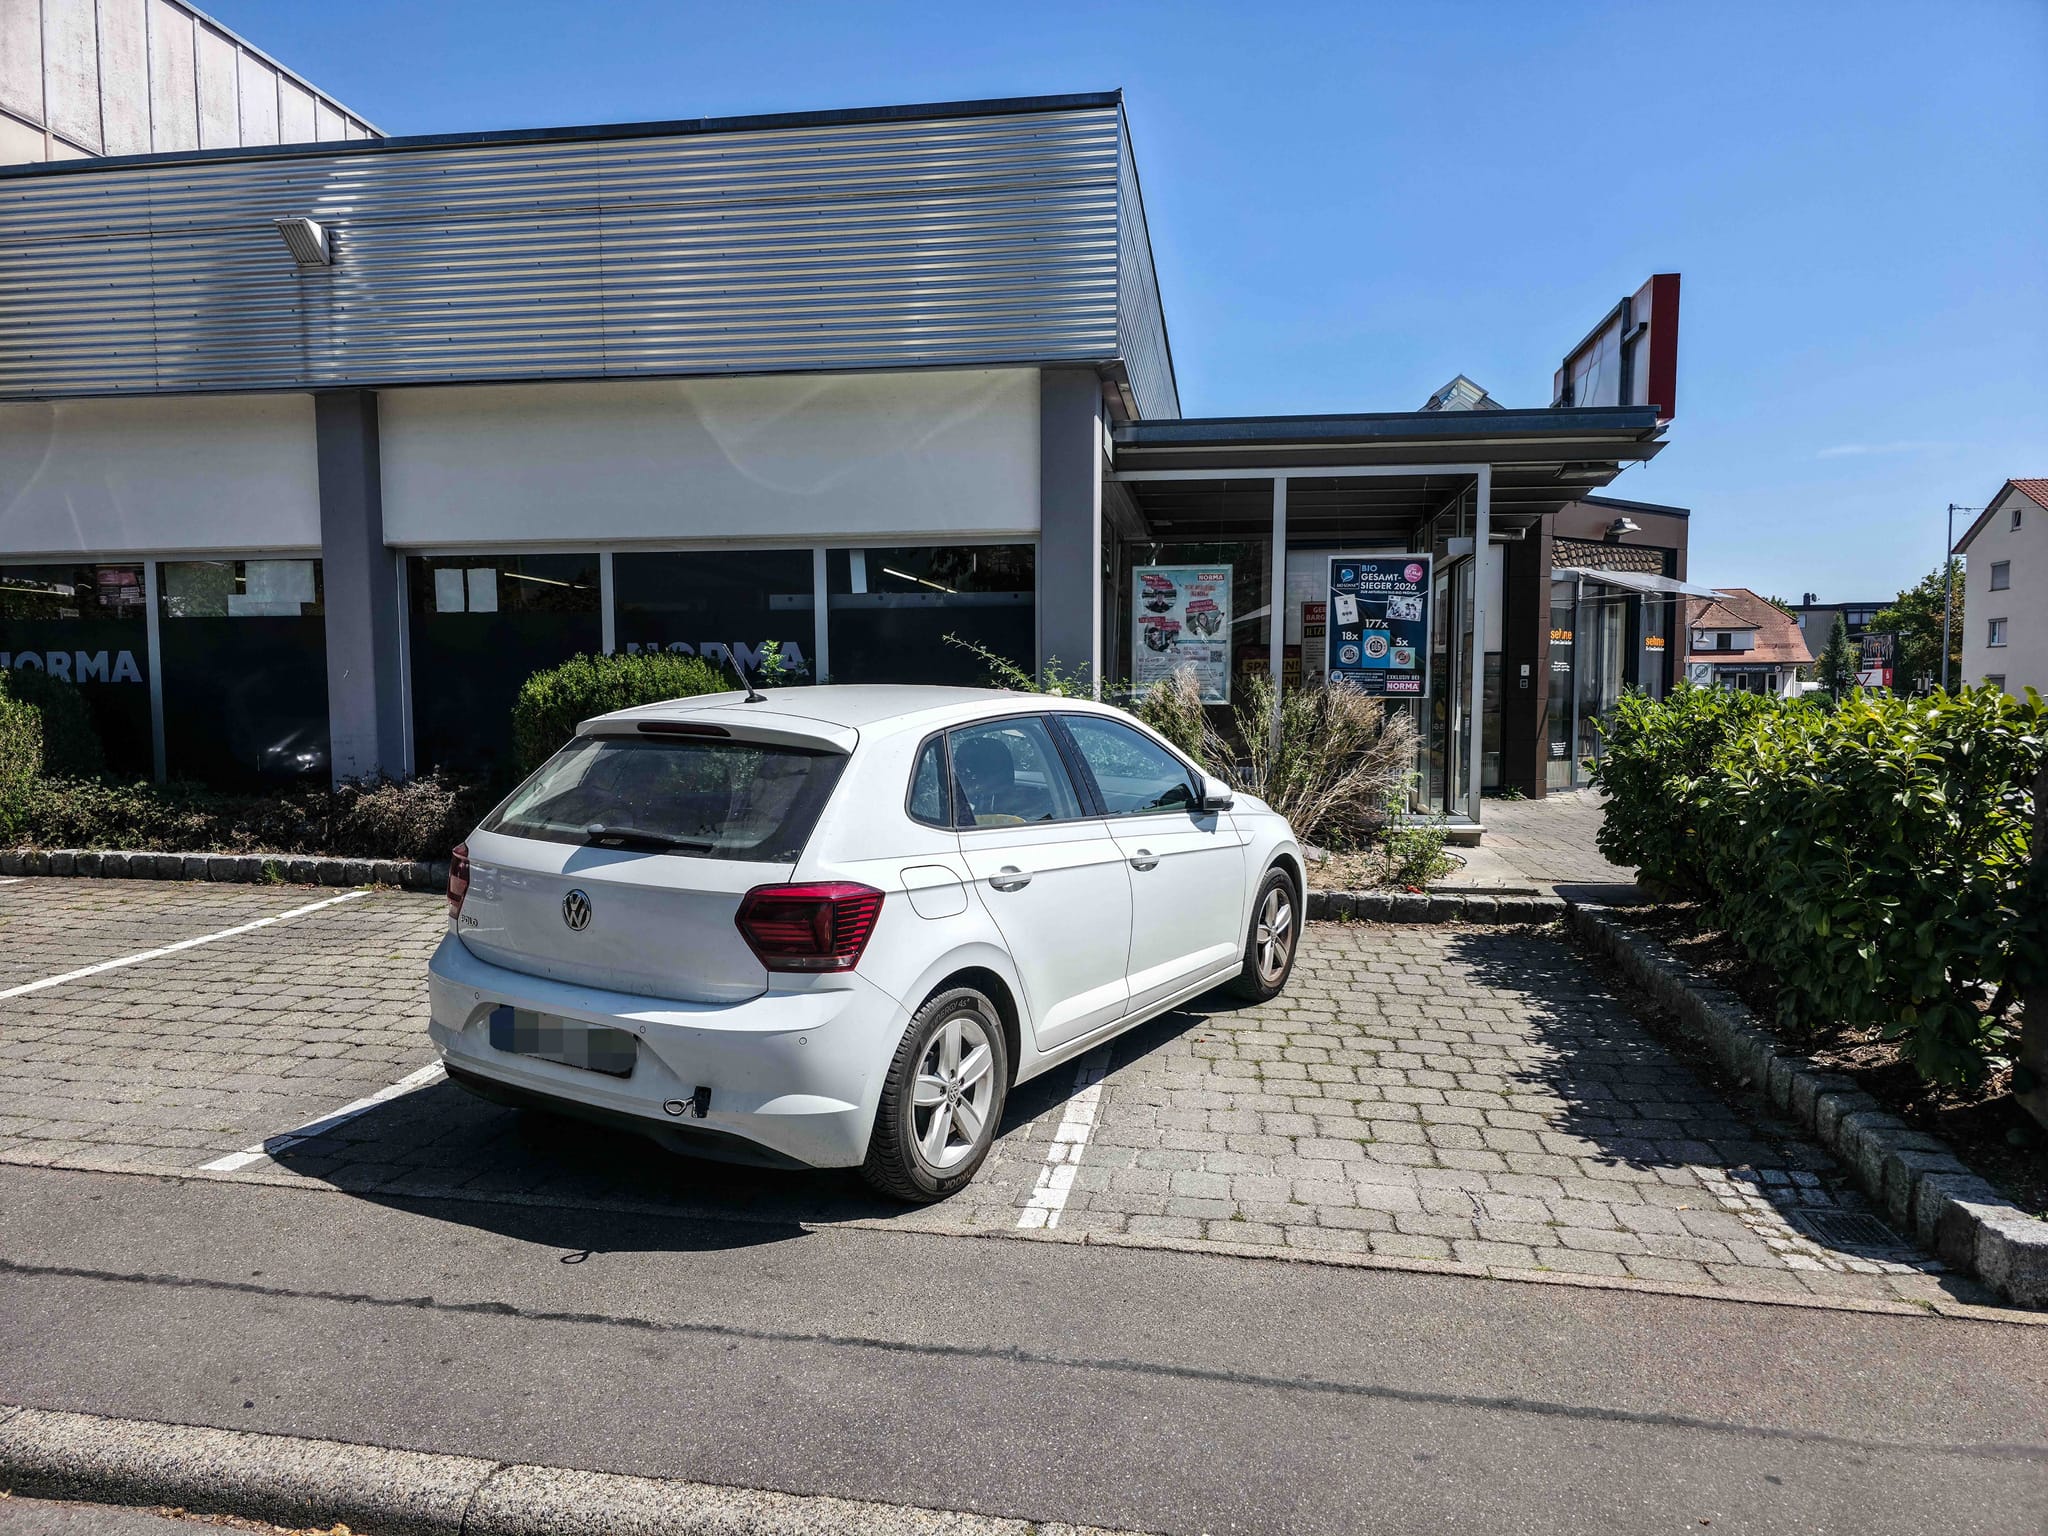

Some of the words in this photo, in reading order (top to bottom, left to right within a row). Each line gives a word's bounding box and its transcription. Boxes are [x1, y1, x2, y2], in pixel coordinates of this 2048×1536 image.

[1361, 564, 1378, 572] BIO
[1361, 573, 1402, 581] GESAMT-
[1360, 582, 1392, 590] SIEGER
[1394, 582, 1417, 591] 2026
[1365, 619, 1389, 629] 177x
[1342, 631, 1359, 640] 18x
[1395, 637, 1409, 646] 5x
[1645, 635, 1665, 647] sehne
[1246, 661, 1299, 672] SPAN!
[1386, 682, 1420, 690] NORMA
